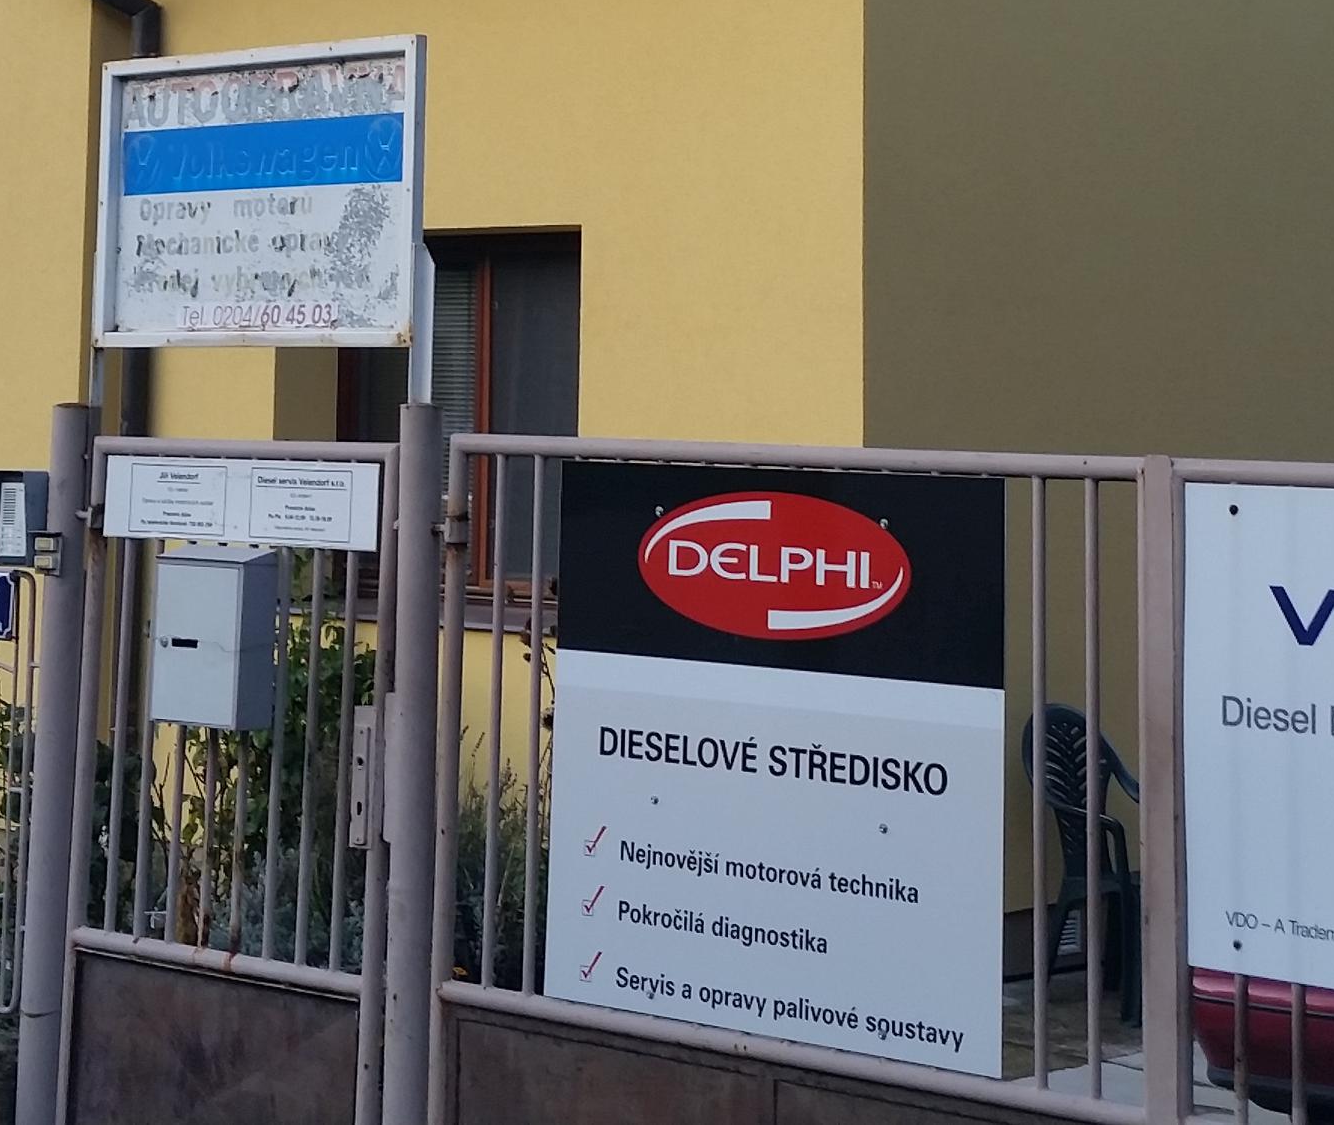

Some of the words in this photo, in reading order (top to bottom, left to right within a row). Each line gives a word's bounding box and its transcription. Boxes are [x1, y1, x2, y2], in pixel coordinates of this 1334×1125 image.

[139, 198, 211, 225] Opravy
[213, 304, 280, 327] 0204/60
[286, 305, 306, 325] 45
[668, 538, 870, 589] DELPHI
[1221, 695, 1317, 735] Diesel
[599, 725, 758, 774] DIESELOVÉ
[768, 743, 948, 796] STŘEDISKO
[620, 840, 719, 877] Nejnovější
[725, 859, 822, 890] motorová
[829, 872, 919, 904] technika
[618, 900, 706, 935] Pokročilá
[711, 915, 828, 954] diagnostika
[1225, 910, 1259, 930] VDO
[1274, 918, 1285, 935] A
[616, 966, 676, 997] Servis
[681, 981, 693, 1000] a
[699, 986, 767, 1018] opravy
[773, 997, 860, 1030] palivové
[865, 1015, 965, 1053] soustavy
